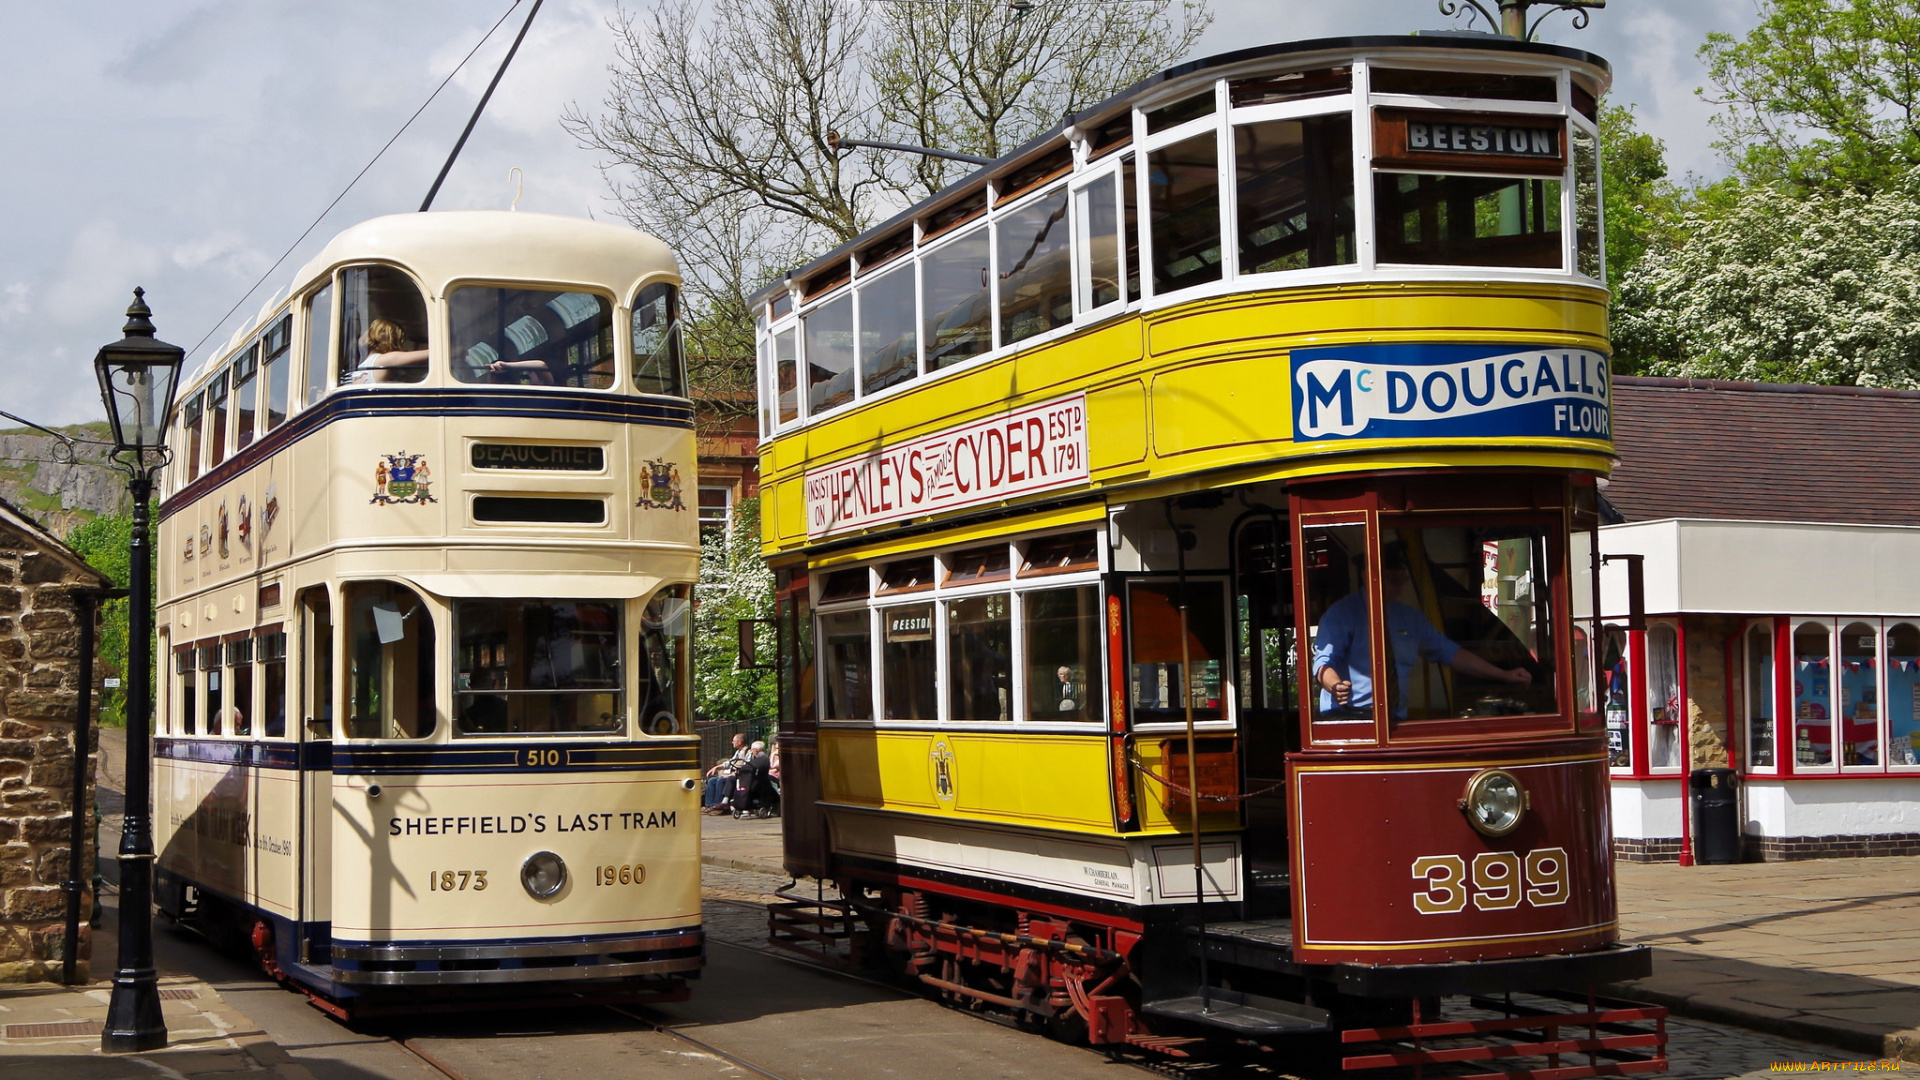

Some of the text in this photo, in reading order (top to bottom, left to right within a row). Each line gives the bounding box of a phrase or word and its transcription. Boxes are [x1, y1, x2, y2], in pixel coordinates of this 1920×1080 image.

[1410, 123, 1550, 154] BEESTON
[1553, 404, 1609, 435] FLOUR
[473, 444, 600, 464] BEAUCHIEF
[1052, 441, 1081, 474] 1791
[830, 416, 1048, 523] HENLEY'S FAMOUS CYDER
[807, 474, 830, 503] INSIST
[814, 504, 826, 527] ON
[526, 749, 560, 766] 510
[389, 810, 677, 836] SHEFFIELD'S LAST TRAM
[430, 870, 488, 892] 1873
[595, 863, 647, 887] 1960
[1411, 846, 1571, 915] 399
